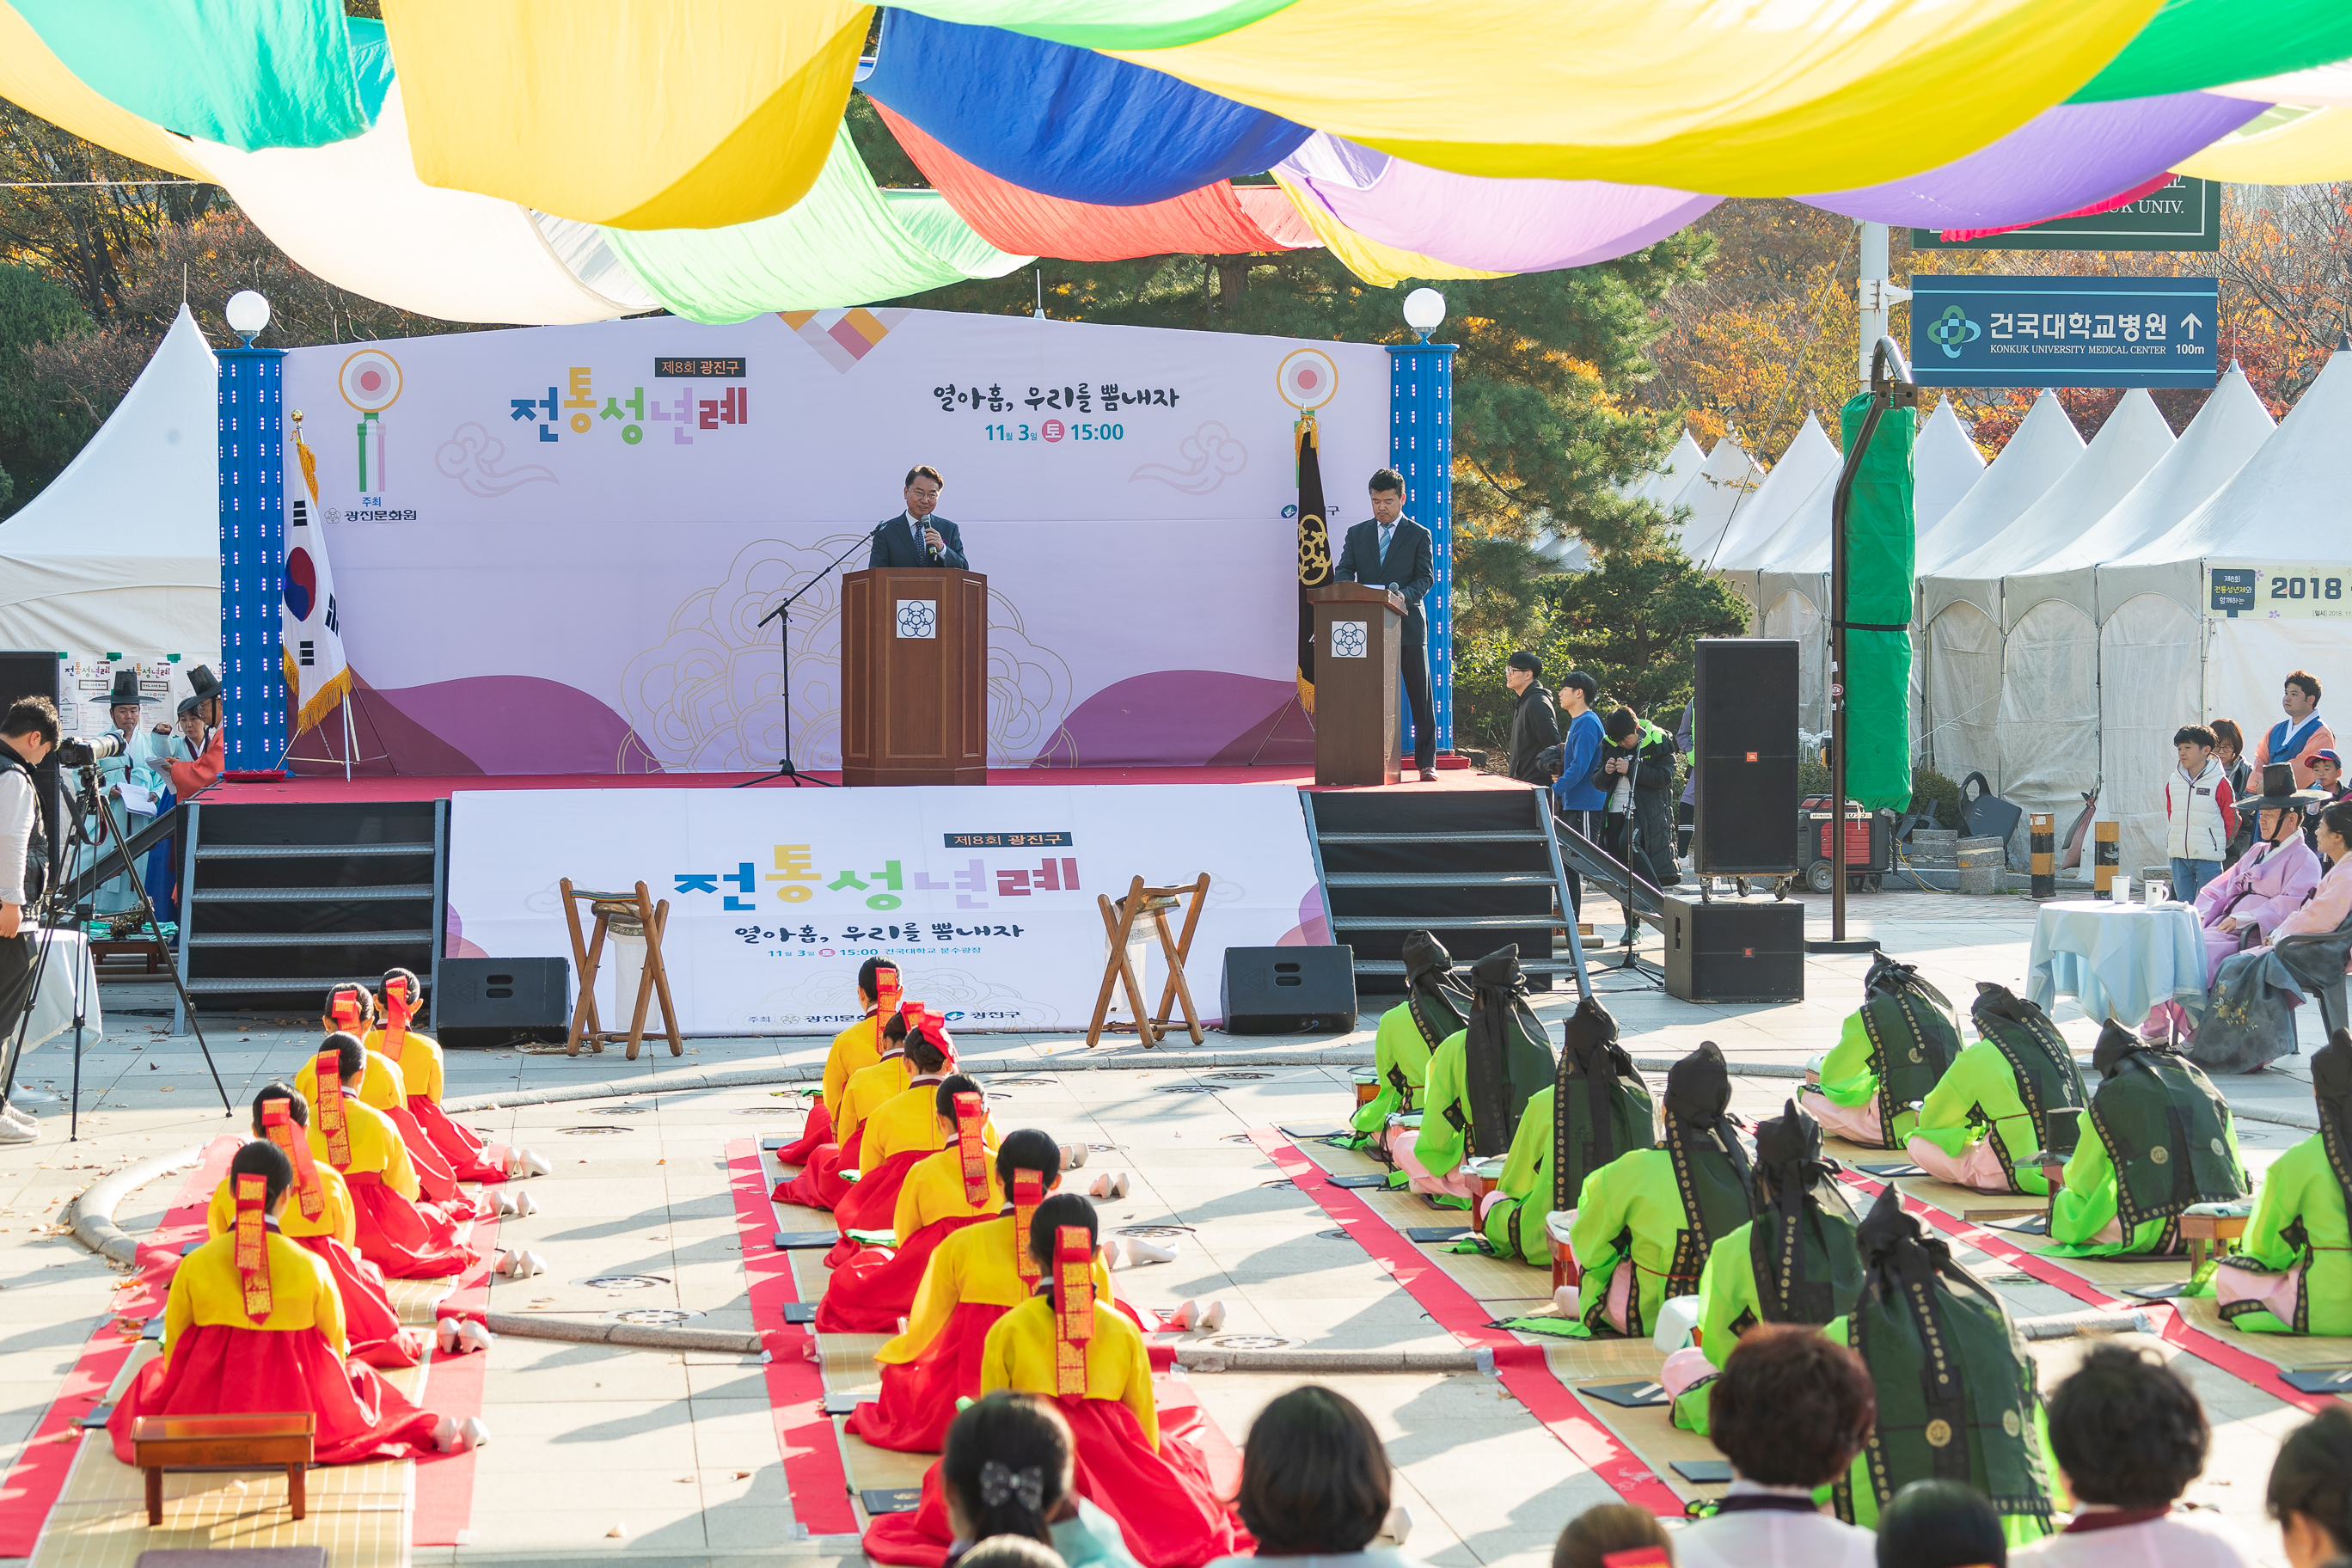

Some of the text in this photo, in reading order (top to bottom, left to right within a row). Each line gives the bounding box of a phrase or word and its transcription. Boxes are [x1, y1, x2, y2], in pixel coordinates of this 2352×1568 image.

[2137, 199, 2184, 214] UNIV.
[1990, 312, 2166, 342] 건국대학교병원
[1990, 345, 2166, 355] KONKUK UNIVERSITY MEDICAL CENTER
[2176, 344, 2205, 355] 100m
[662, 360, 739, 375] 제8회 광진구
[511, 367, 747, 444] 전통성년례
[934, 383, 1180, 413] 열아홉, 우리를 뽐내자
[984, 422, 1124, 441] 11월 3일 토 15:00
[362, 496, 382, 507] 주최
[344, 509, 418, 523] 광진문화원
[2271, 577, 2342, 600] 2018
[2219, 597, 2245, 605] 함께하는
[64, 661, 111, 678] 전통성년례
[953, 832, 1063, 847] 제8회 광진구
[674, 844, 1081, 911] 전통성년례
[735, 922, 1025, 944] 열아홉, 우리를 뽐내자
